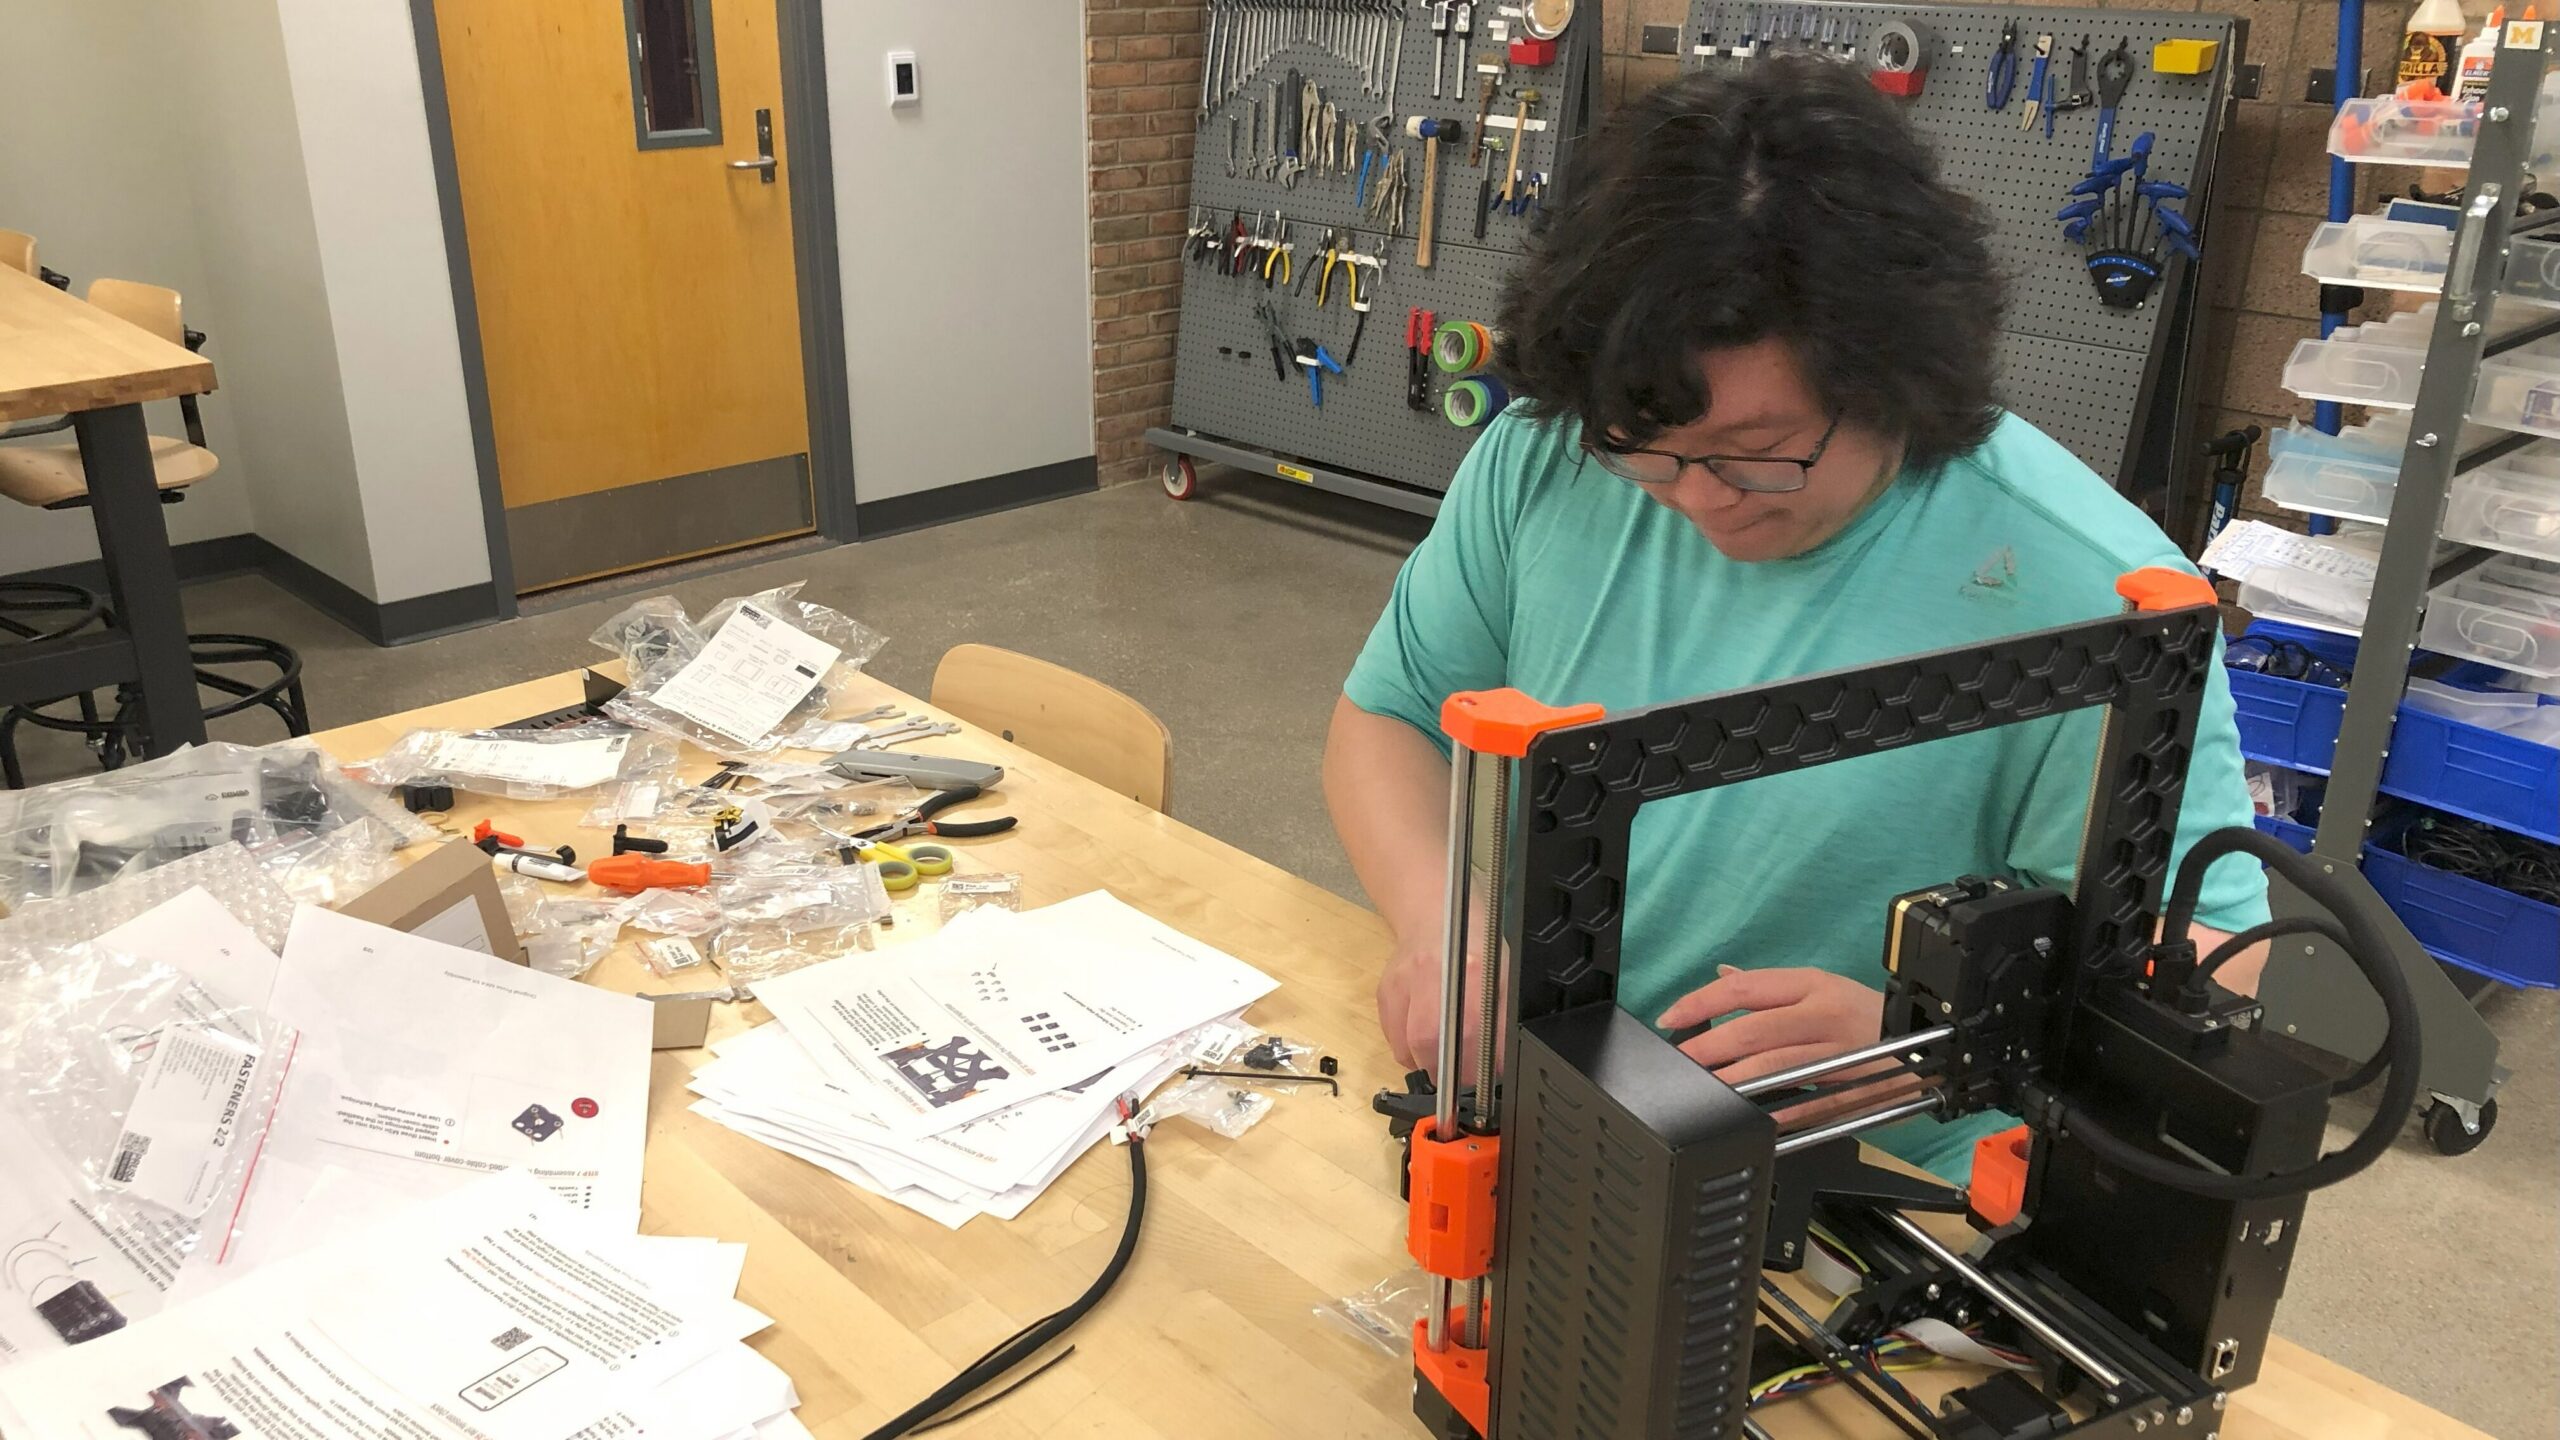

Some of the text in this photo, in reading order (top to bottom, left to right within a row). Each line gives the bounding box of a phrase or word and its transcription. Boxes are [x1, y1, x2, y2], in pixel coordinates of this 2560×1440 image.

[212, 1054, 256, 1147] FASTENERS 2/2
[122, 1151, 142, 1183] PRUSA
